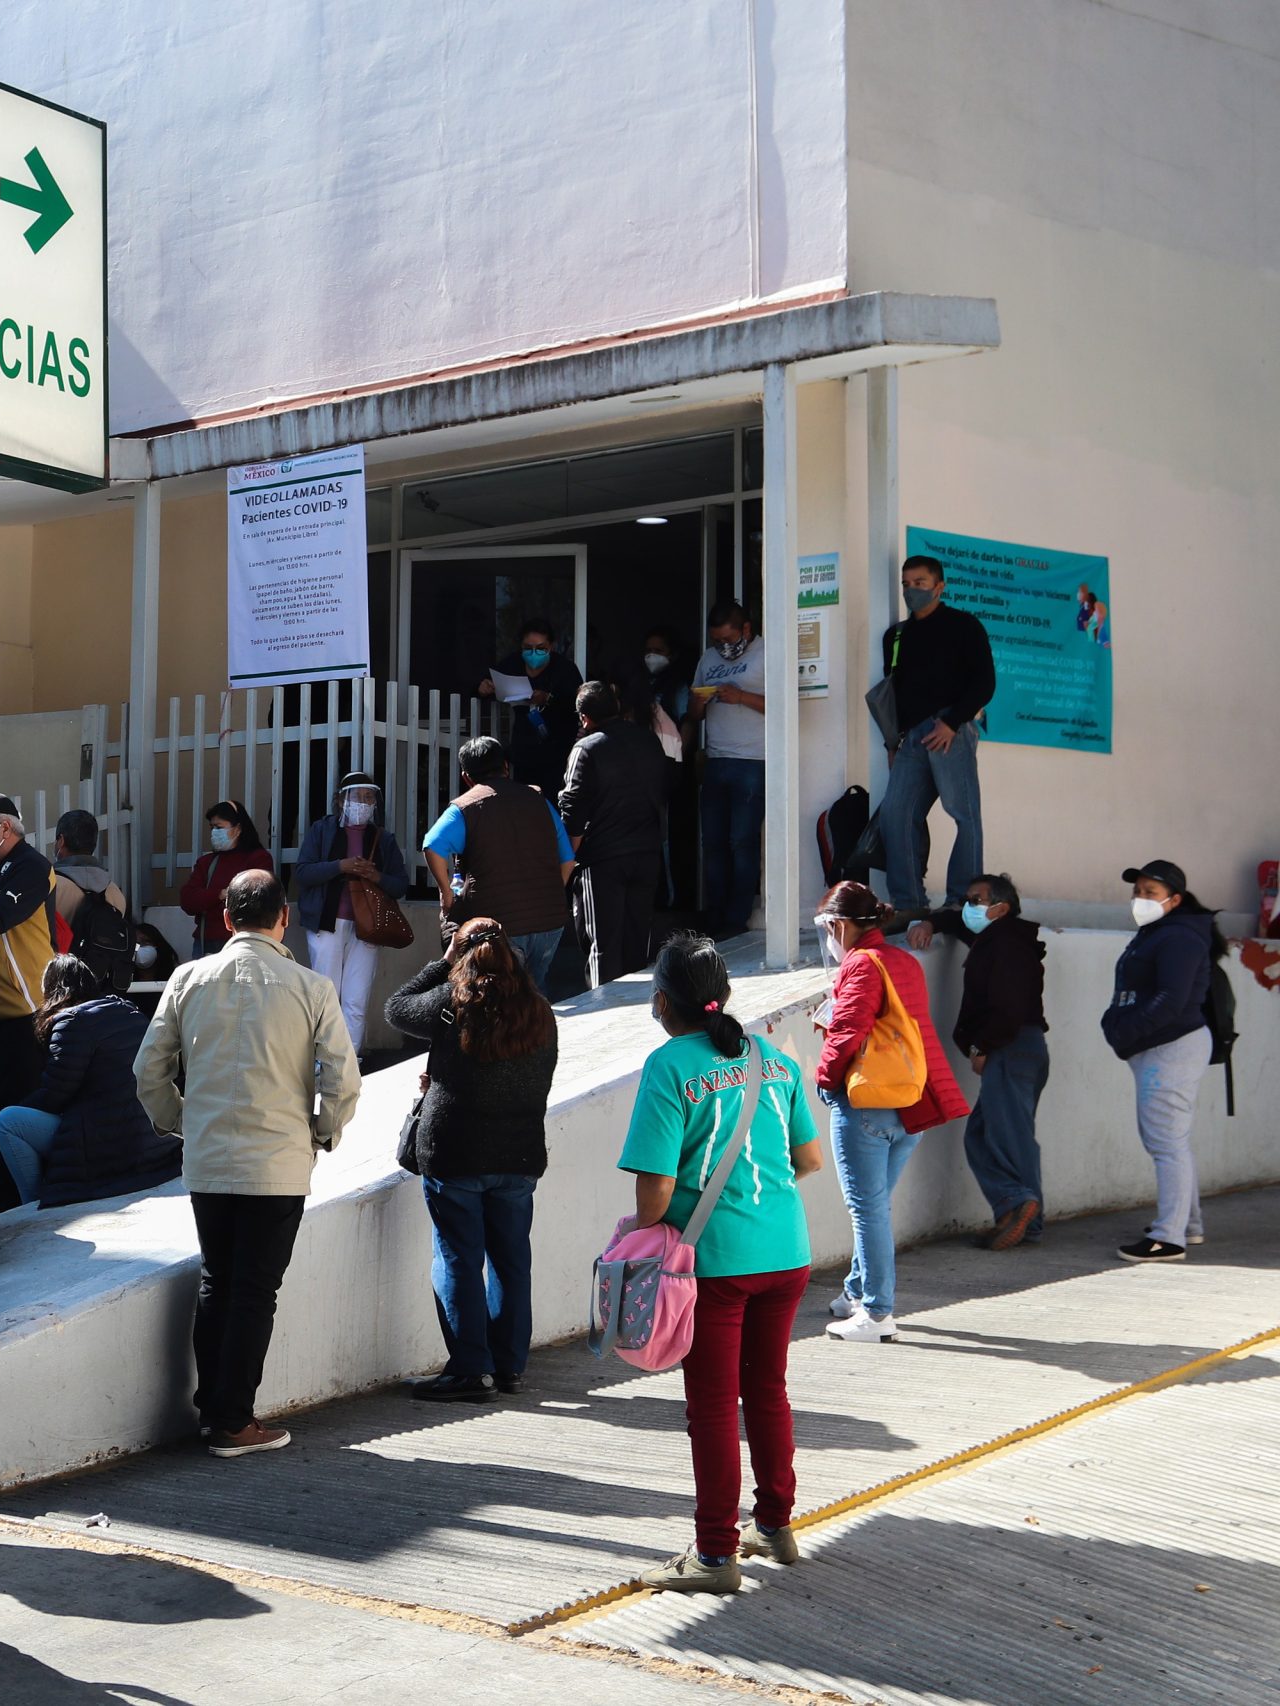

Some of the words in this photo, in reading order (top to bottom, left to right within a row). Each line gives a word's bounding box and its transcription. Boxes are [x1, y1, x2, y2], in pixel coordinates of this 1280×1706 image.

[243, 468, 275, 480] MÉXICO
[245, 482, 343, 507] VIDEOLLAMADAS
[241, 509, 292, 524] Pacientes
[293, 498, 348, 515] COVID-19
[814, 564, 835, 573] FAVOR
